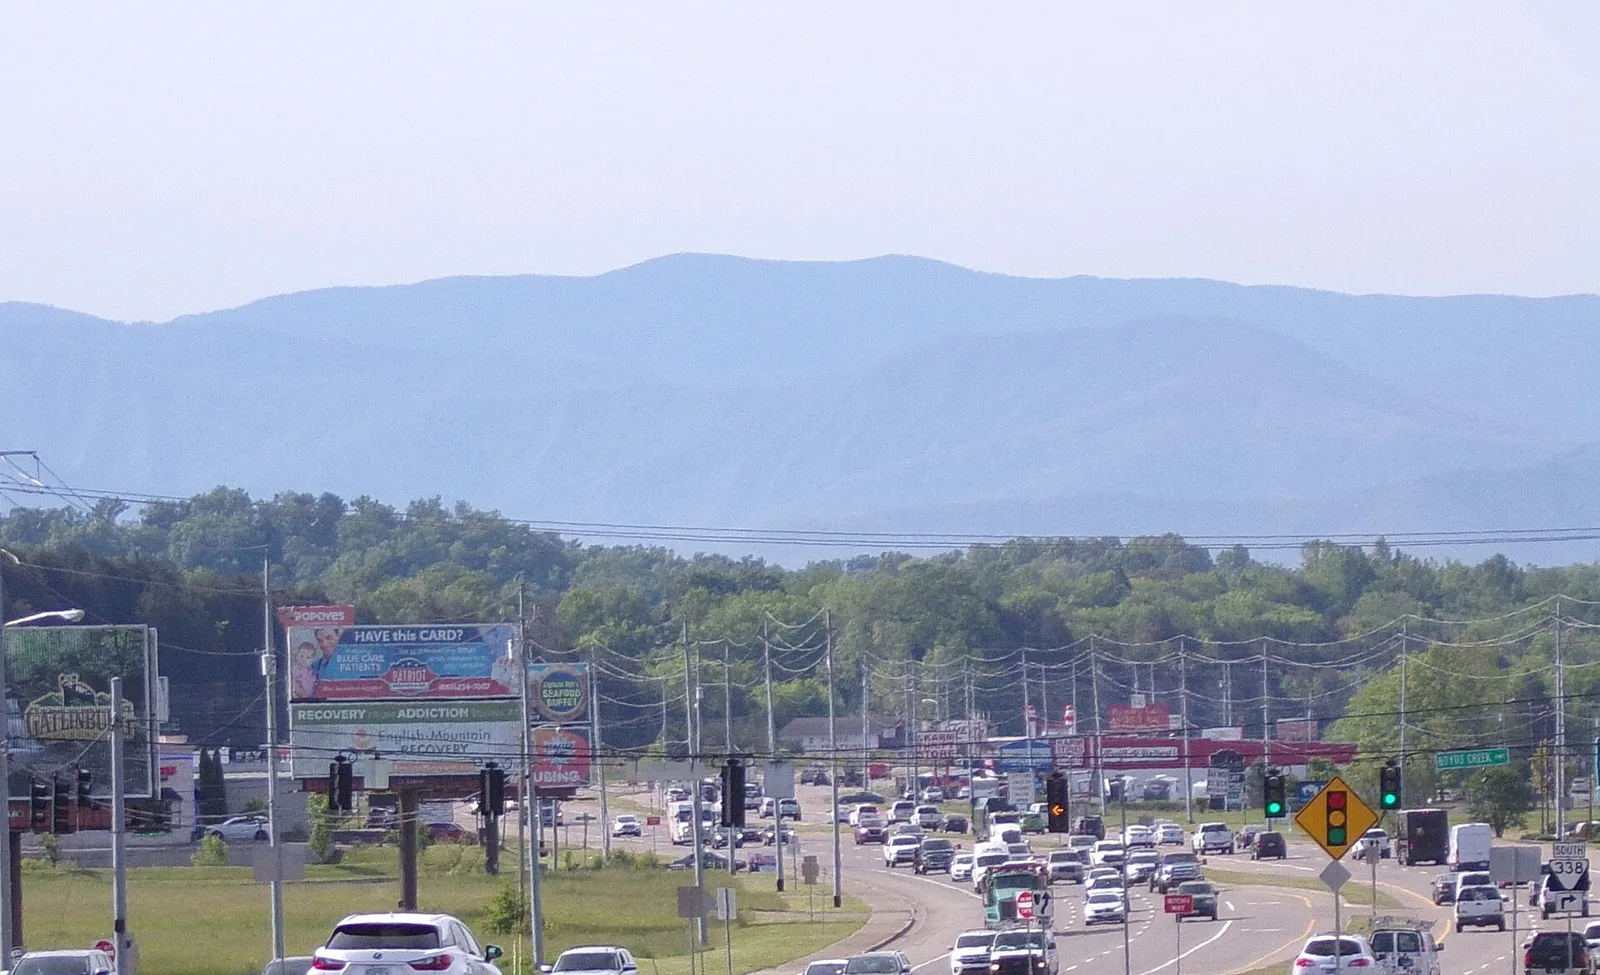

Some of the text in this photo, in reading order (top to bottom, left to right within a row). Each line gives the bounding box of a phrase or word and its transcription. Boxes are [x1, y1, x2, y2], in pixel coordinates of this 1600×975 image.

[355, 629, 463, 642] HAVE this CARD?
[340, 663, 380, 672] PATIENTS
[392, 669, 426, 682] PATRIOT
[542, 689, 580, 698] SEAFOOD
[547, 698, 577, 707] BUFFET
[24, 703, 135, 737] GATLINBUG
[297, 709, 366, 720] RECOVERY
[397, 708, 469, 719] ADDICTION
[431, 730, 490, 740] Mountain
[401, 744, 468, 754] RECOVERY
[1467, 752, 1492, 764] CREEK
[533, 771, 581, 783] UBING
[1555, 845, 1583, 855] SOUTH
[1555, 862, 1583, 874] 338
